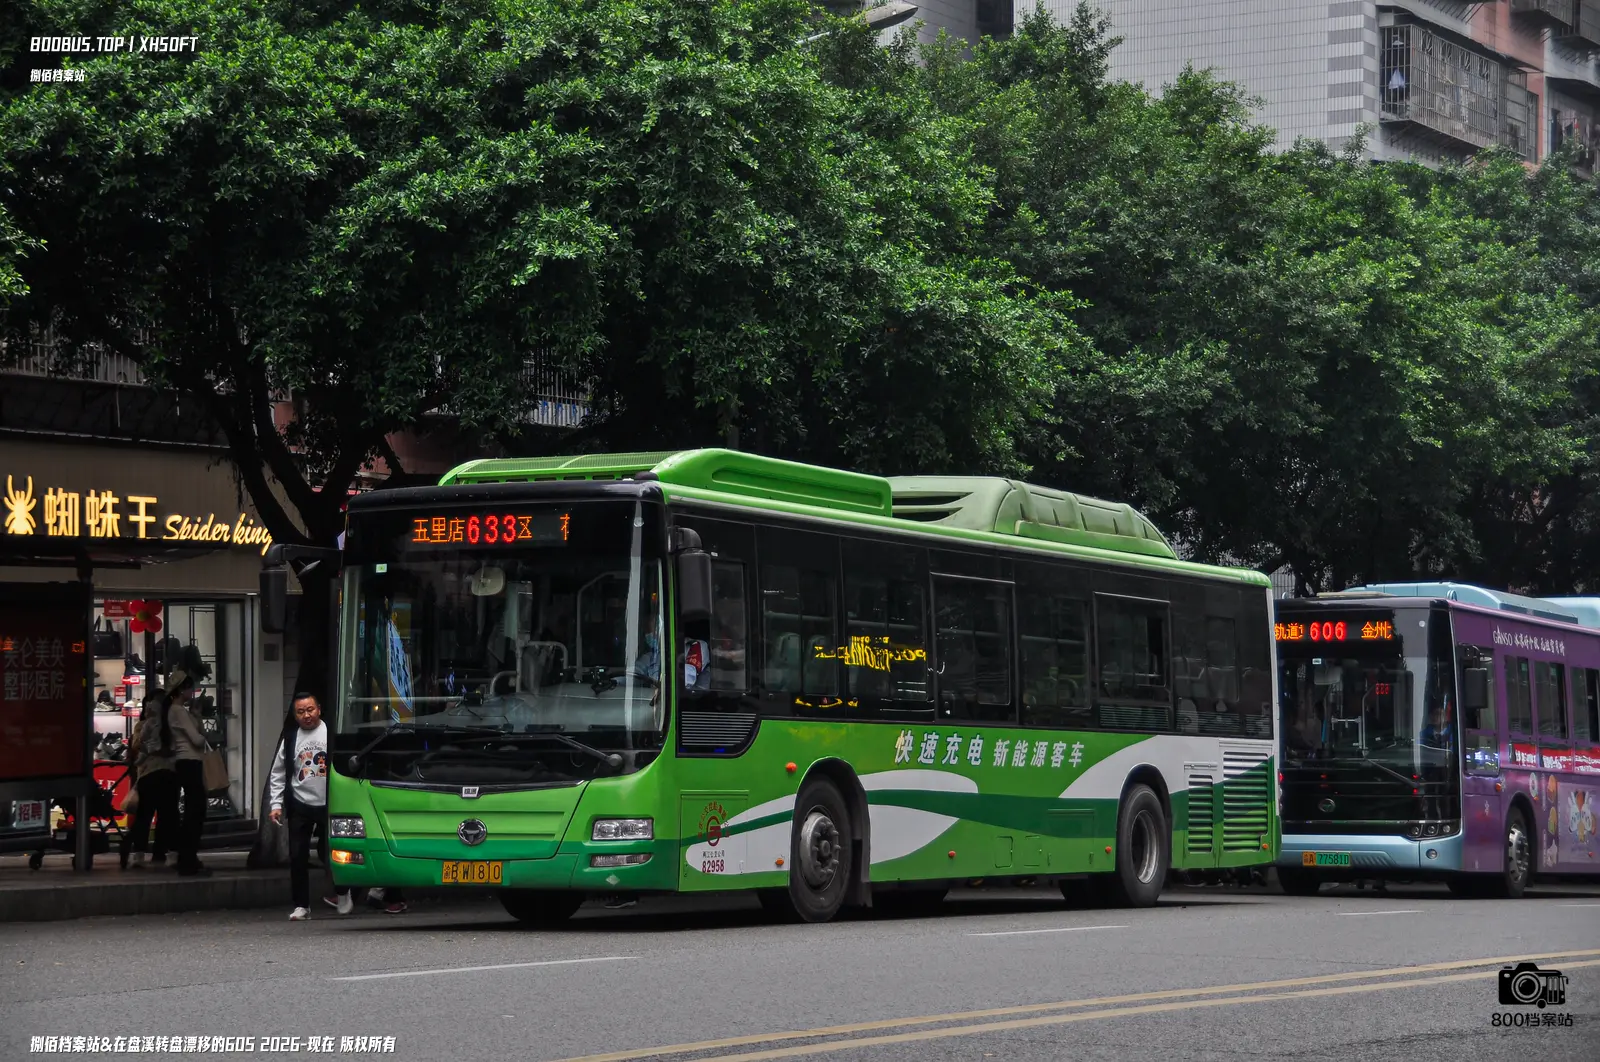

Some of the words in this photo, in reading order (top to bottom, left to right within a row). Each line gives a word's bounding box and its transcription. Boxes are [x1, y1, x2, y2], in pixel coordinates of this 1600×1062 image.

[163, 513, 230, 542] Spider
[233, 513, 273, 556] king
[1310, 621, 1346, 641] 606
[4, 671, 65, 700] 整形医院
[894, 730, 984, 766] 快速充电
[993, 739, 1084, 767] 新能源客车
[702, 859, 725, 874] 82958
